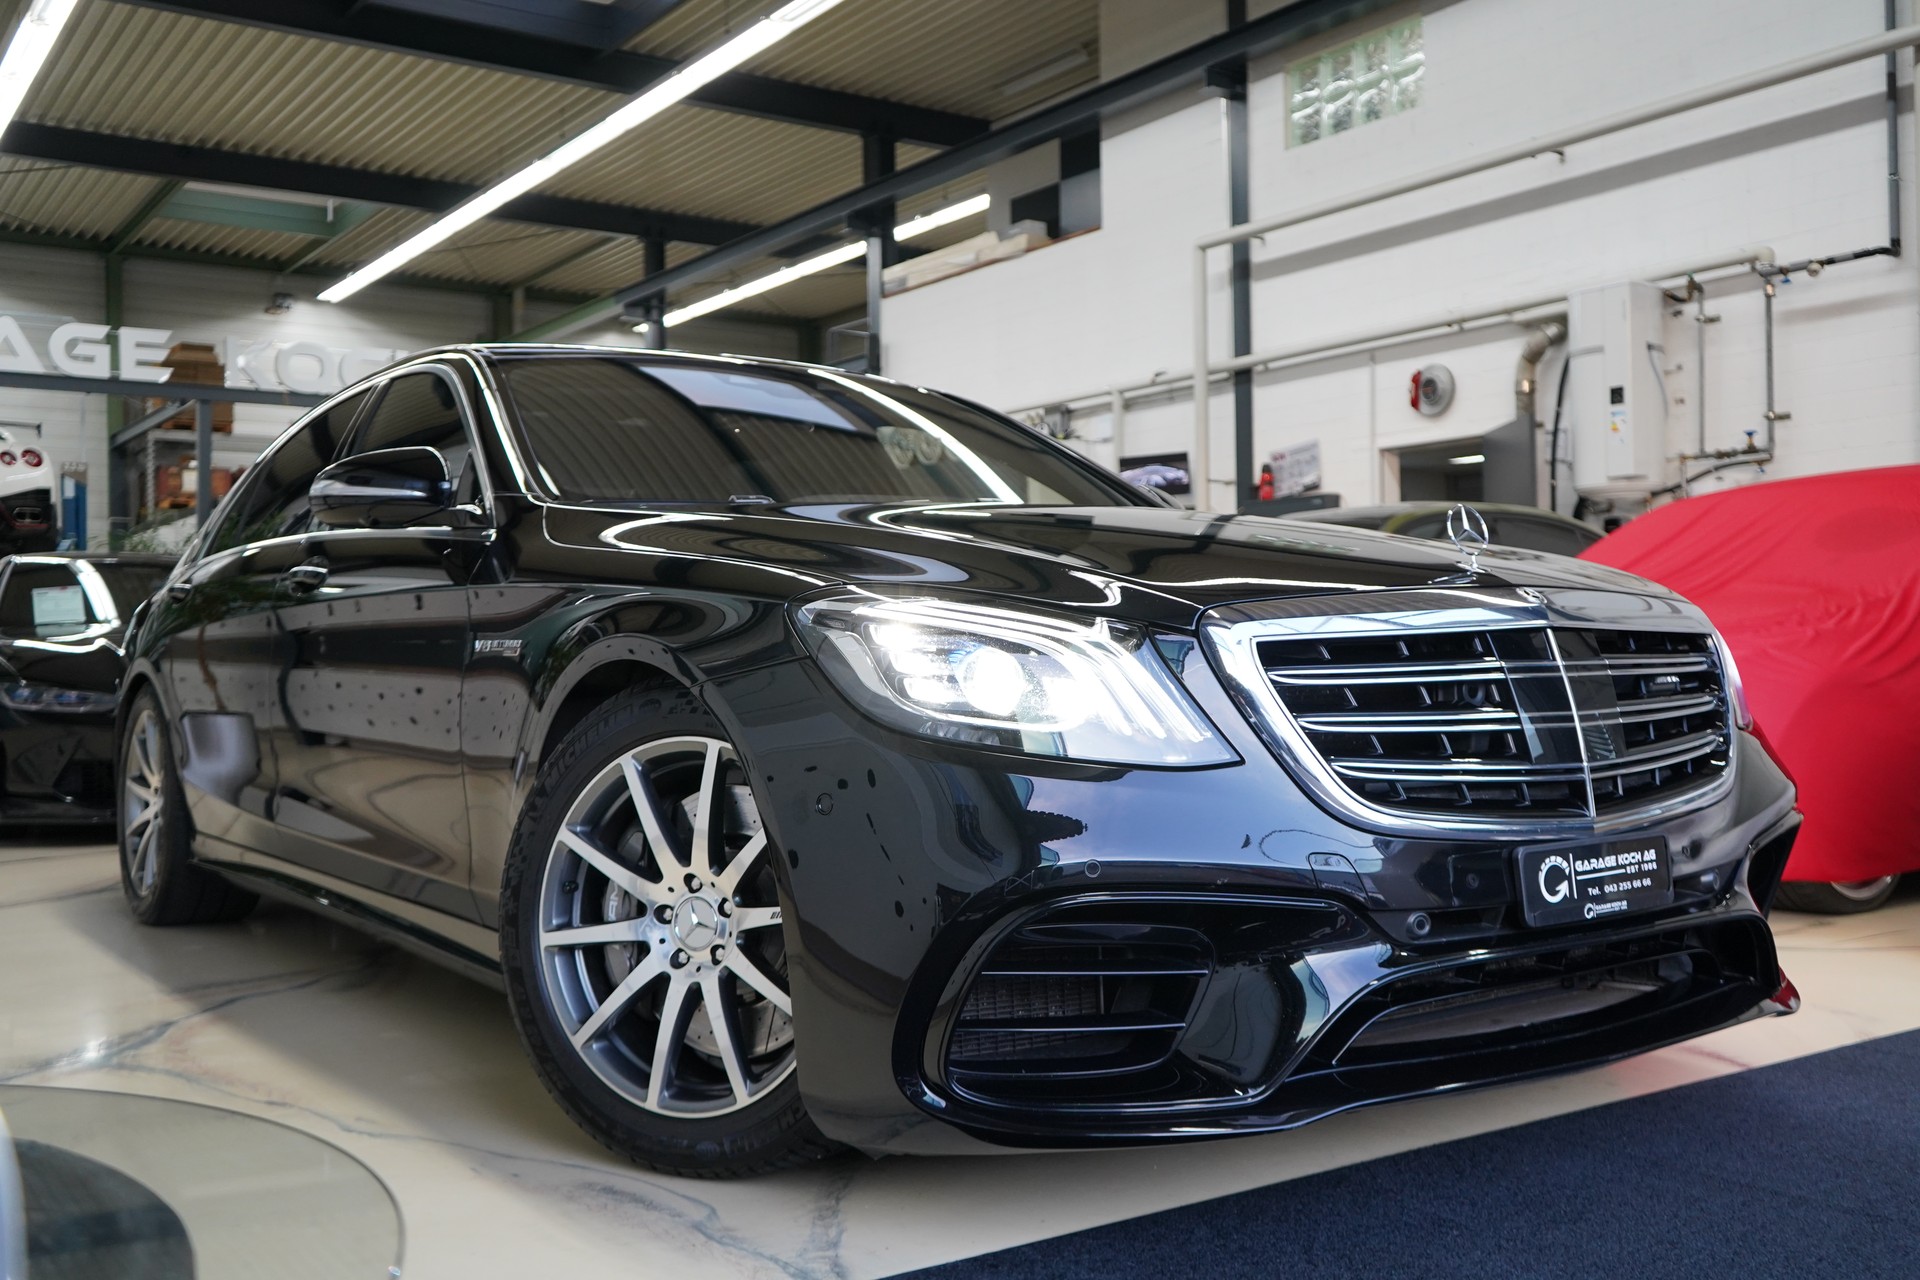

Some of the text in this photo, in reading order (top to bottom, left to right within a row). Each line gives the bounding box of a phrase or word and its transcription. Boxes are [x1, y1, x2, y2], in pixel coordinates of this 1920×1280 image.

[224, 336, 409, 395] KOC
[544, 702, 635, 794] MICHELIN
[1575, 849, 1657, 872] GARAGE KOCH AG
[1626, 864, 1639, 874] EST
[1588, 887, 1601, 896] Tel.
[1604, 883, 1618, 894] 043
